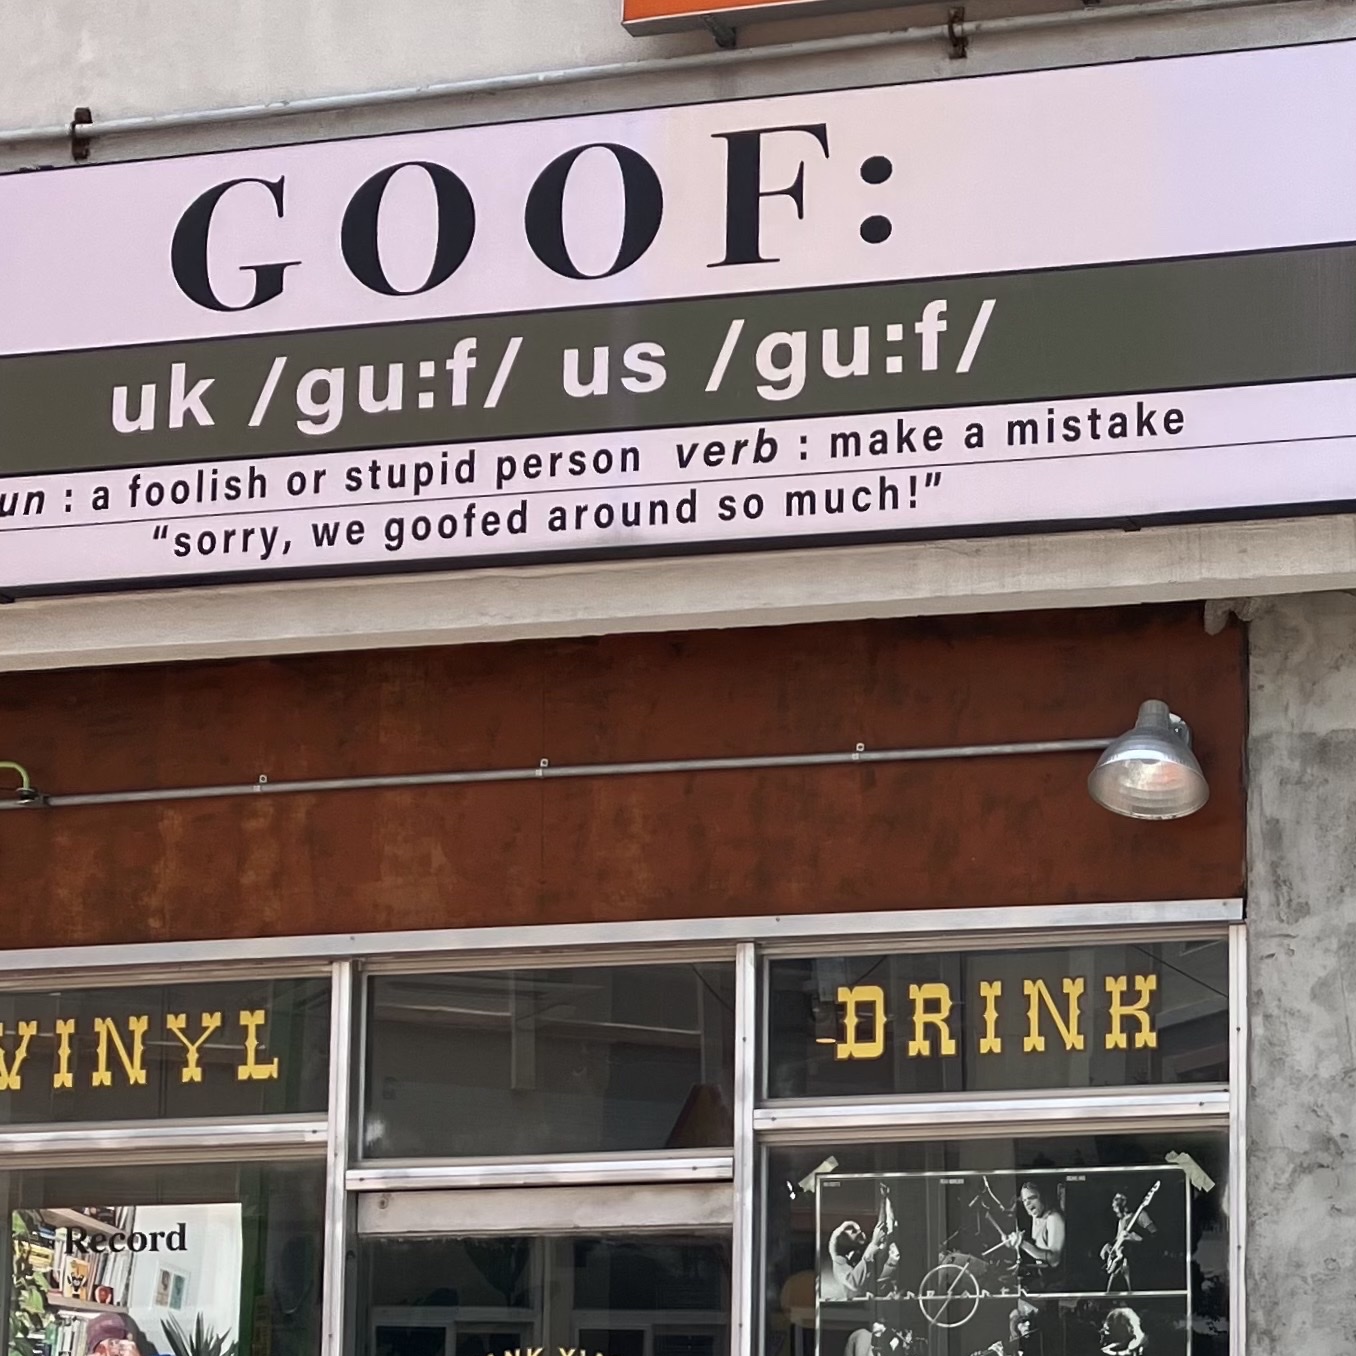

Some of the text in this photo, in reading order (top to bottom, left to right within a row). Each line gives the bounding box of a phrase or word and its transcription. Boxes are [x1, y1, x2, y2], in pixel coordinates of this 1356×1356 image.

[171, 121, 894, 313] GOOF:
[110, 299, 998, 435] uk /gu:f/ us /gu:f/
[91, 486, 110, 511] a
[127, 466, 269, 508] foolish
[286, 464, 328, 496] or
[344, 449, 477, 492] stupid
[495, 441, 641, 488] person
[676, 428, 779, 470] verb
[828, 417, 945, 460] make
[963, 422, 987, 450] a
[1006, 401, 1187, 447] mistake
[311, 519, 365, 548] we
[384, 498, 529, 551] goofed
[547, 488, 697, 532] around
[717, 492, 765, 522] so
[0, 1008, 279, 1092] VINYL
[835, 973, 1158, 1060] DRINK
[65, 1222, 187, 1255] Record
